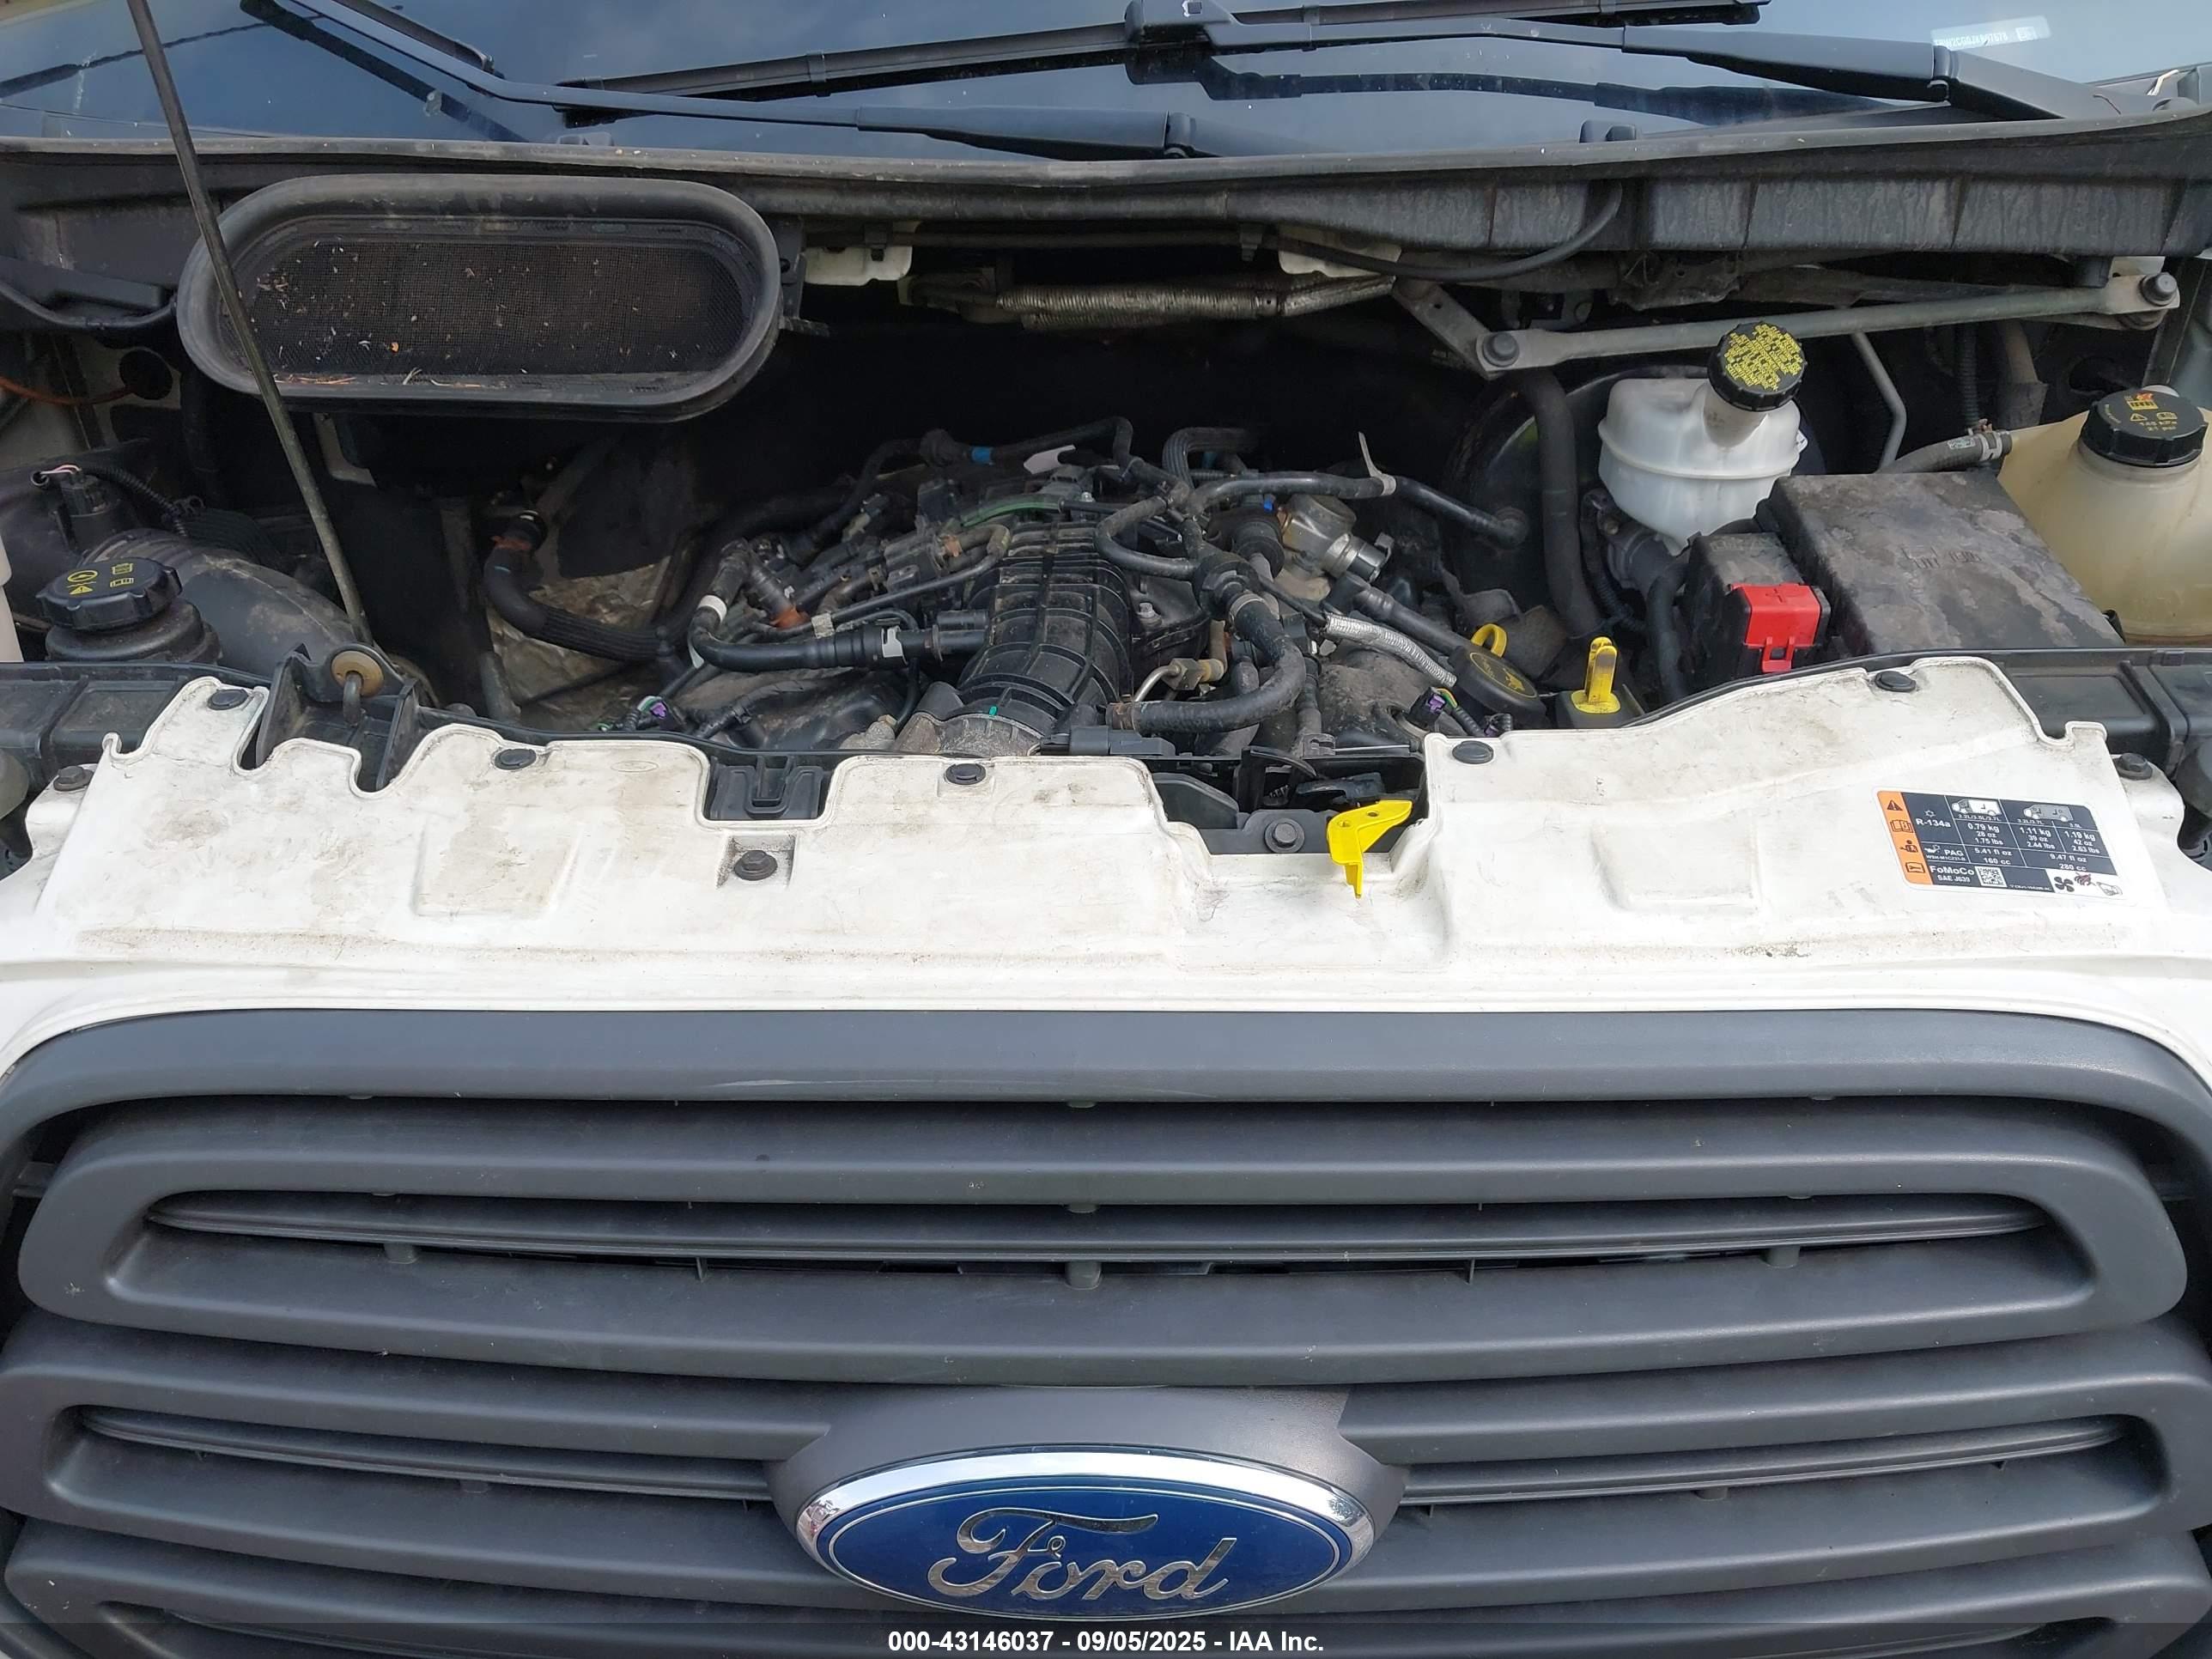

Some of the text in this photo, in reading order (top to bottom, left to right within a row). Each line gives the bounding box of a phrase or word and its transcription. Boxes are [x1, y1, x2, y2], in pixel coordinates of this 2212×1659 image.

[1916, 818, 1951, 828] R-134a
[1987, 824, 2000, 833] kg
[2039, 828, 2051, 837] kg
[2084, 832, 2096, 842] kg
[1929, 865, 1974, 875] FoMoCo
[927, 1507, 1236, 1601] Ford
